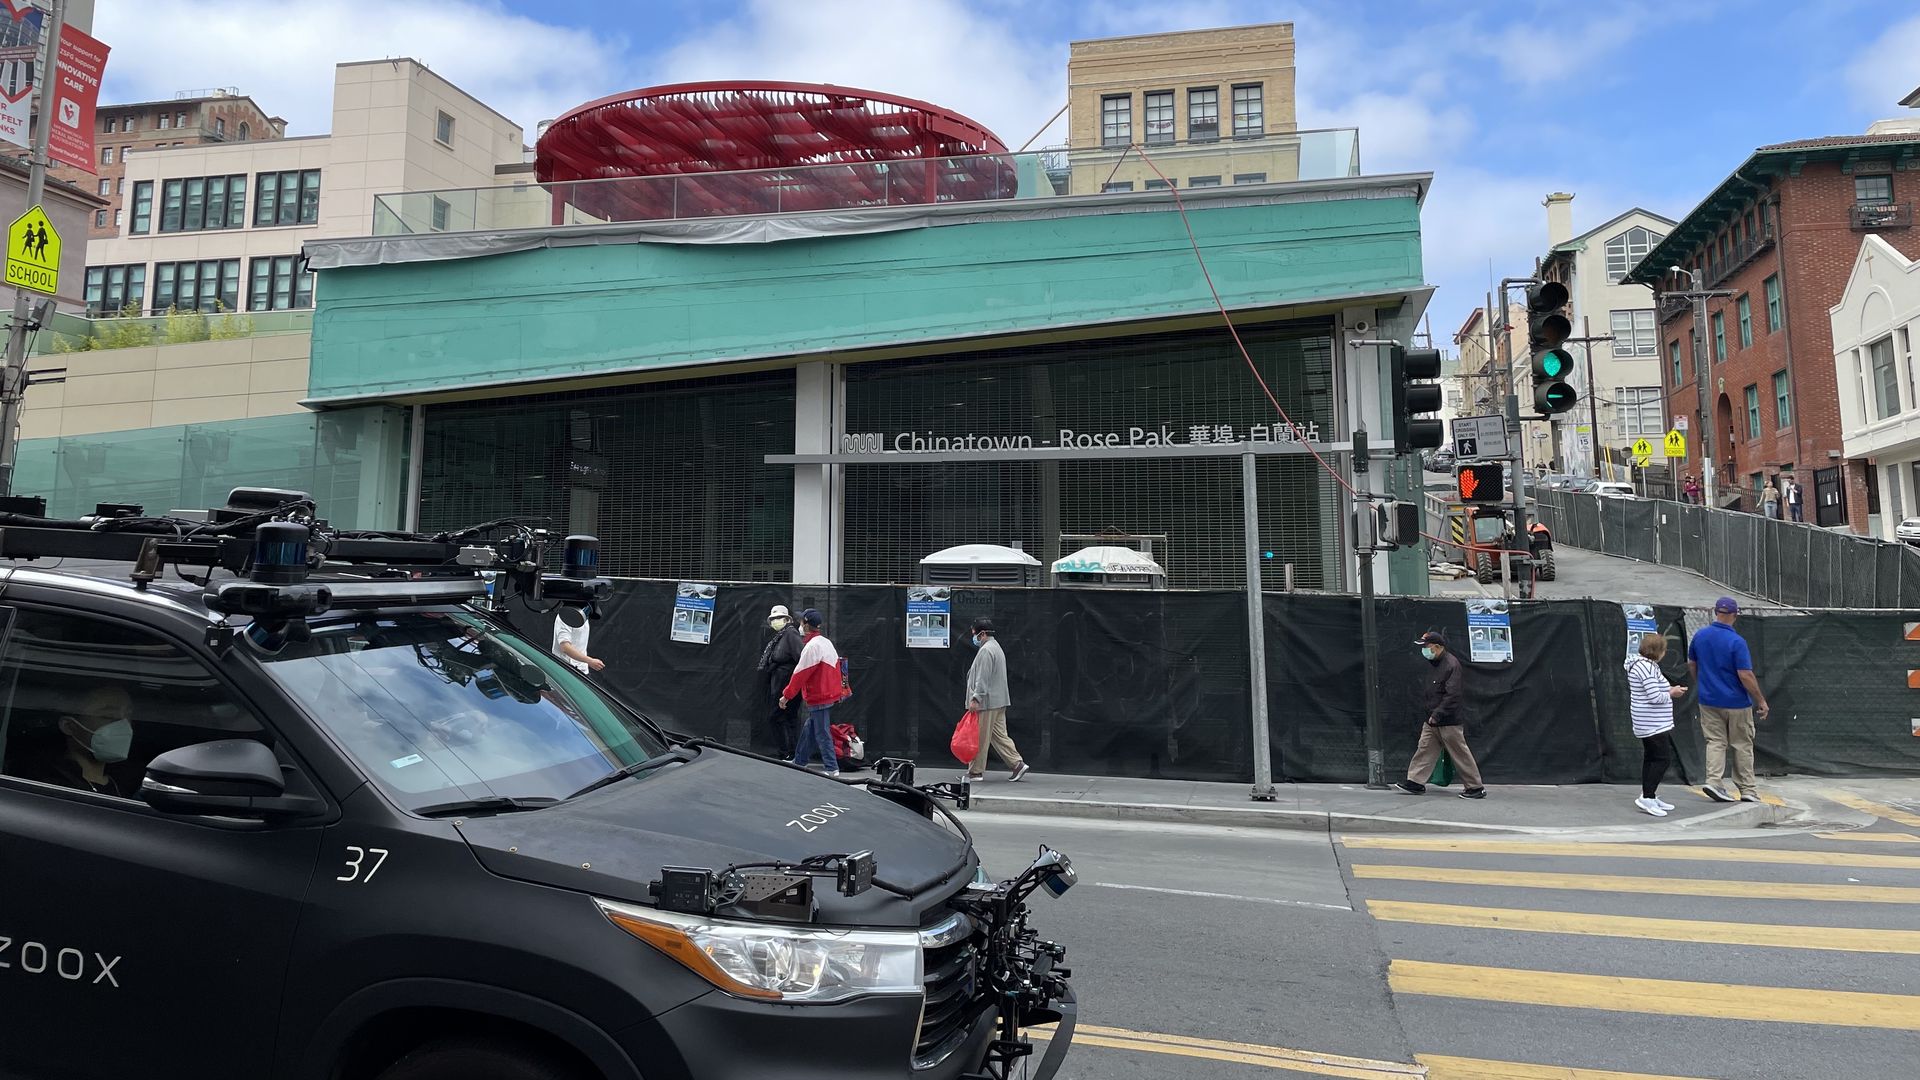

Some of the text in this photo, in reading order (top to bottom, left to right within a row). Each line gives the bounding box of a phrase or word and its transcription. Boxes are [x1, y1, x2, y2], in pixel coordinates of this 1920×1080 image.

[72, 44, 94, 60] support
[93, 54, 102, 64] for
[74, 57, 97, 73] supports
[57, 58, 98, 87] NNOVATIVE
[63, 76, 85, 93] CARE
[9, 264, 54, 288] SCHOOL
[894, 431, 1032, 453] Chinatown
[1060, 429, 1120, 450] Rose
[1129, 425, 1176, 448] Pak
[1580, 438, 1589, 446] 15
[785, 802, 850, 832] ZOOX
[336, 845, 388, 883] 37
